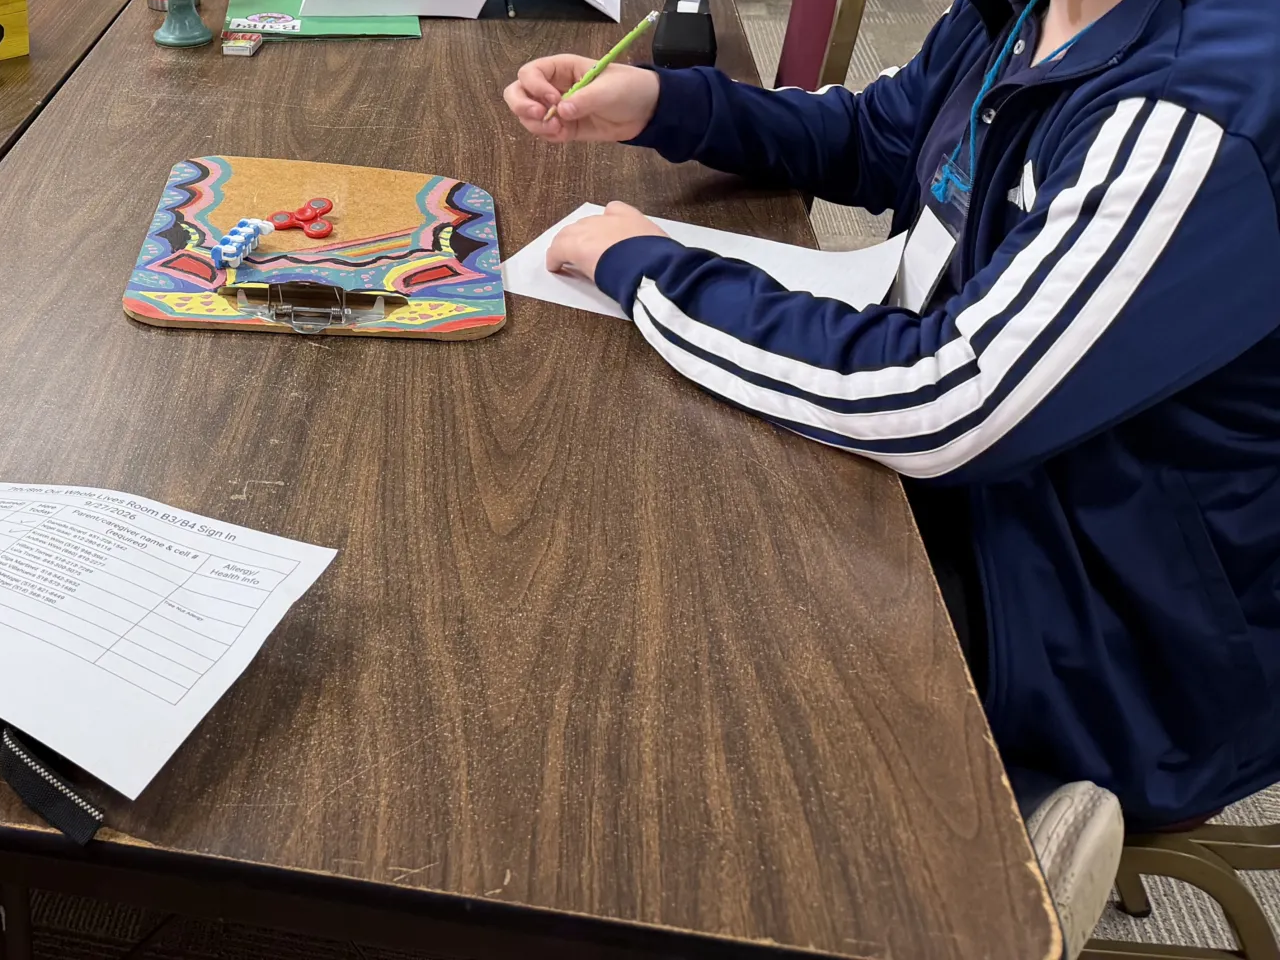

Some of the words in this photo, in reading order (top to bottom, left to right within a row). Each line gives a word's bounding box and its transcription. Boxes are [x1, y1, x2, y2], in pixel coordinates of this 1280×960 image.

[84, 500, 137, 520] 9/27/2026
[97, 494, 124, 504] Lives
[126, 500, 158, 516] Room
[160, 513, 196, 530] B3/B4
[198, 524, 223, 538] Sign
[225, 532, 237, 541] In
[72, 509, 139, 537] Parent/caregiver
[140, 534, 164, 548] name
[174, 548, 191, 558] cell
[106, 528, 148, 550] (required)
[210, 569, 240, 582] Health
[240, 575, 260, 586] Info
[223, 563, 259, 577] Allergy/
[186, 612, 204, 621] Allergy
